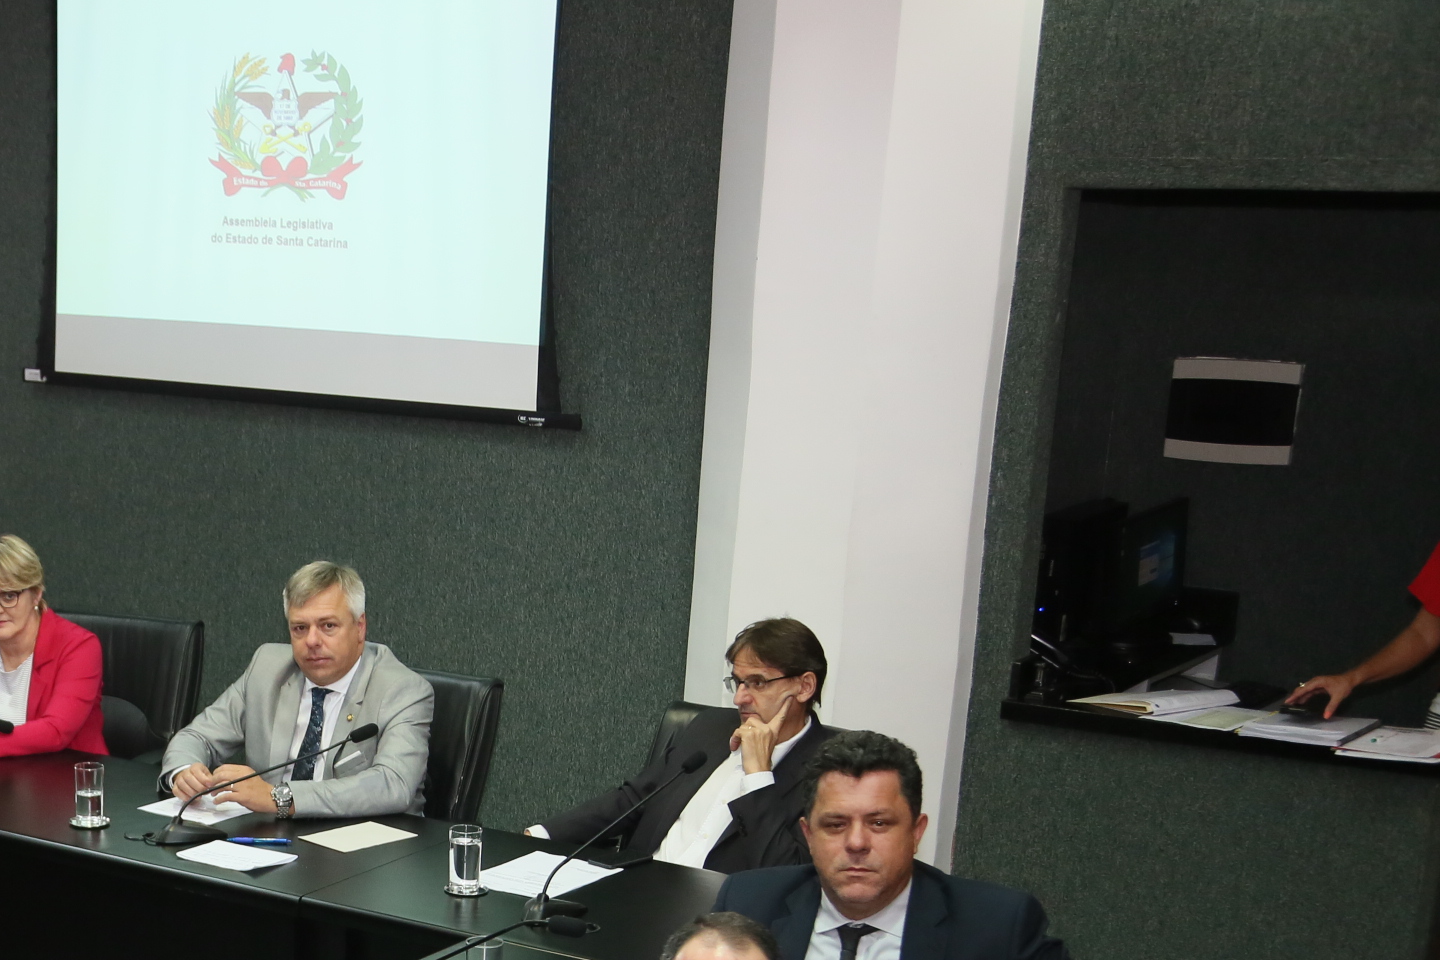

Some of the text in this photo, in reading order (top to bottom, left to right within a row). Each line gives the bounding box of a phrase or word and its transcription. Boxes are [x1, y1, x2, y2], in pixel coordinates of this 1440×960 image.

[233, 177, 258, 187] Estado
[309, 179, 342, 190] Catarina
[222, 216, 334, 231] Assembleia Legislativa
[211, 233, 348, 249] do Estado de Santa Catarina
